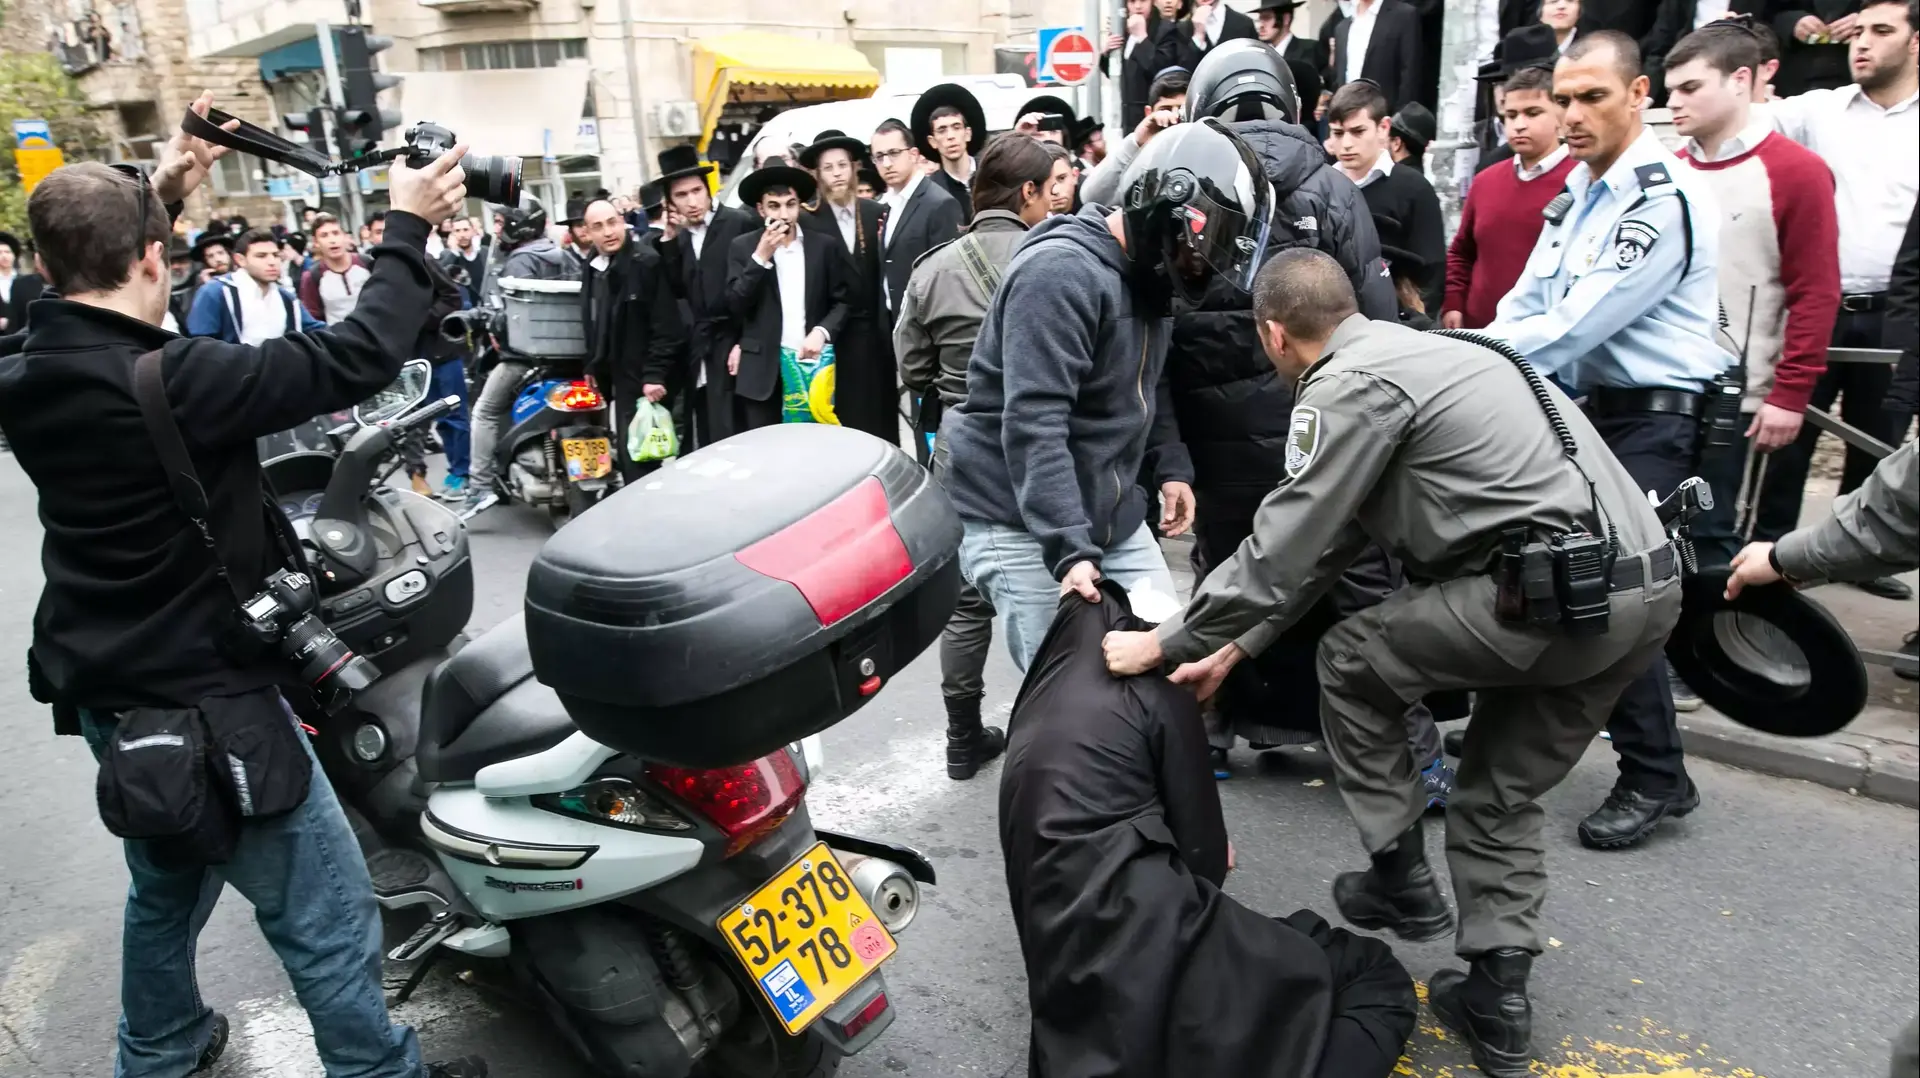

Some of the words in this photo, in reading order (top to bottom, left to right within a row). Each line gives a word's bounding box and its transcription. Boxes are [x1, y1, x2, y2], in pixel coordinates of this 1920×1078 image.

[566, 441, 606, 457] 95-189
[583, 457, 599, 472] 30
[732, 861, 850, 966] 52-378
[797, 926, 851, 986] 78
[784, 987, 800, 1002] IL
